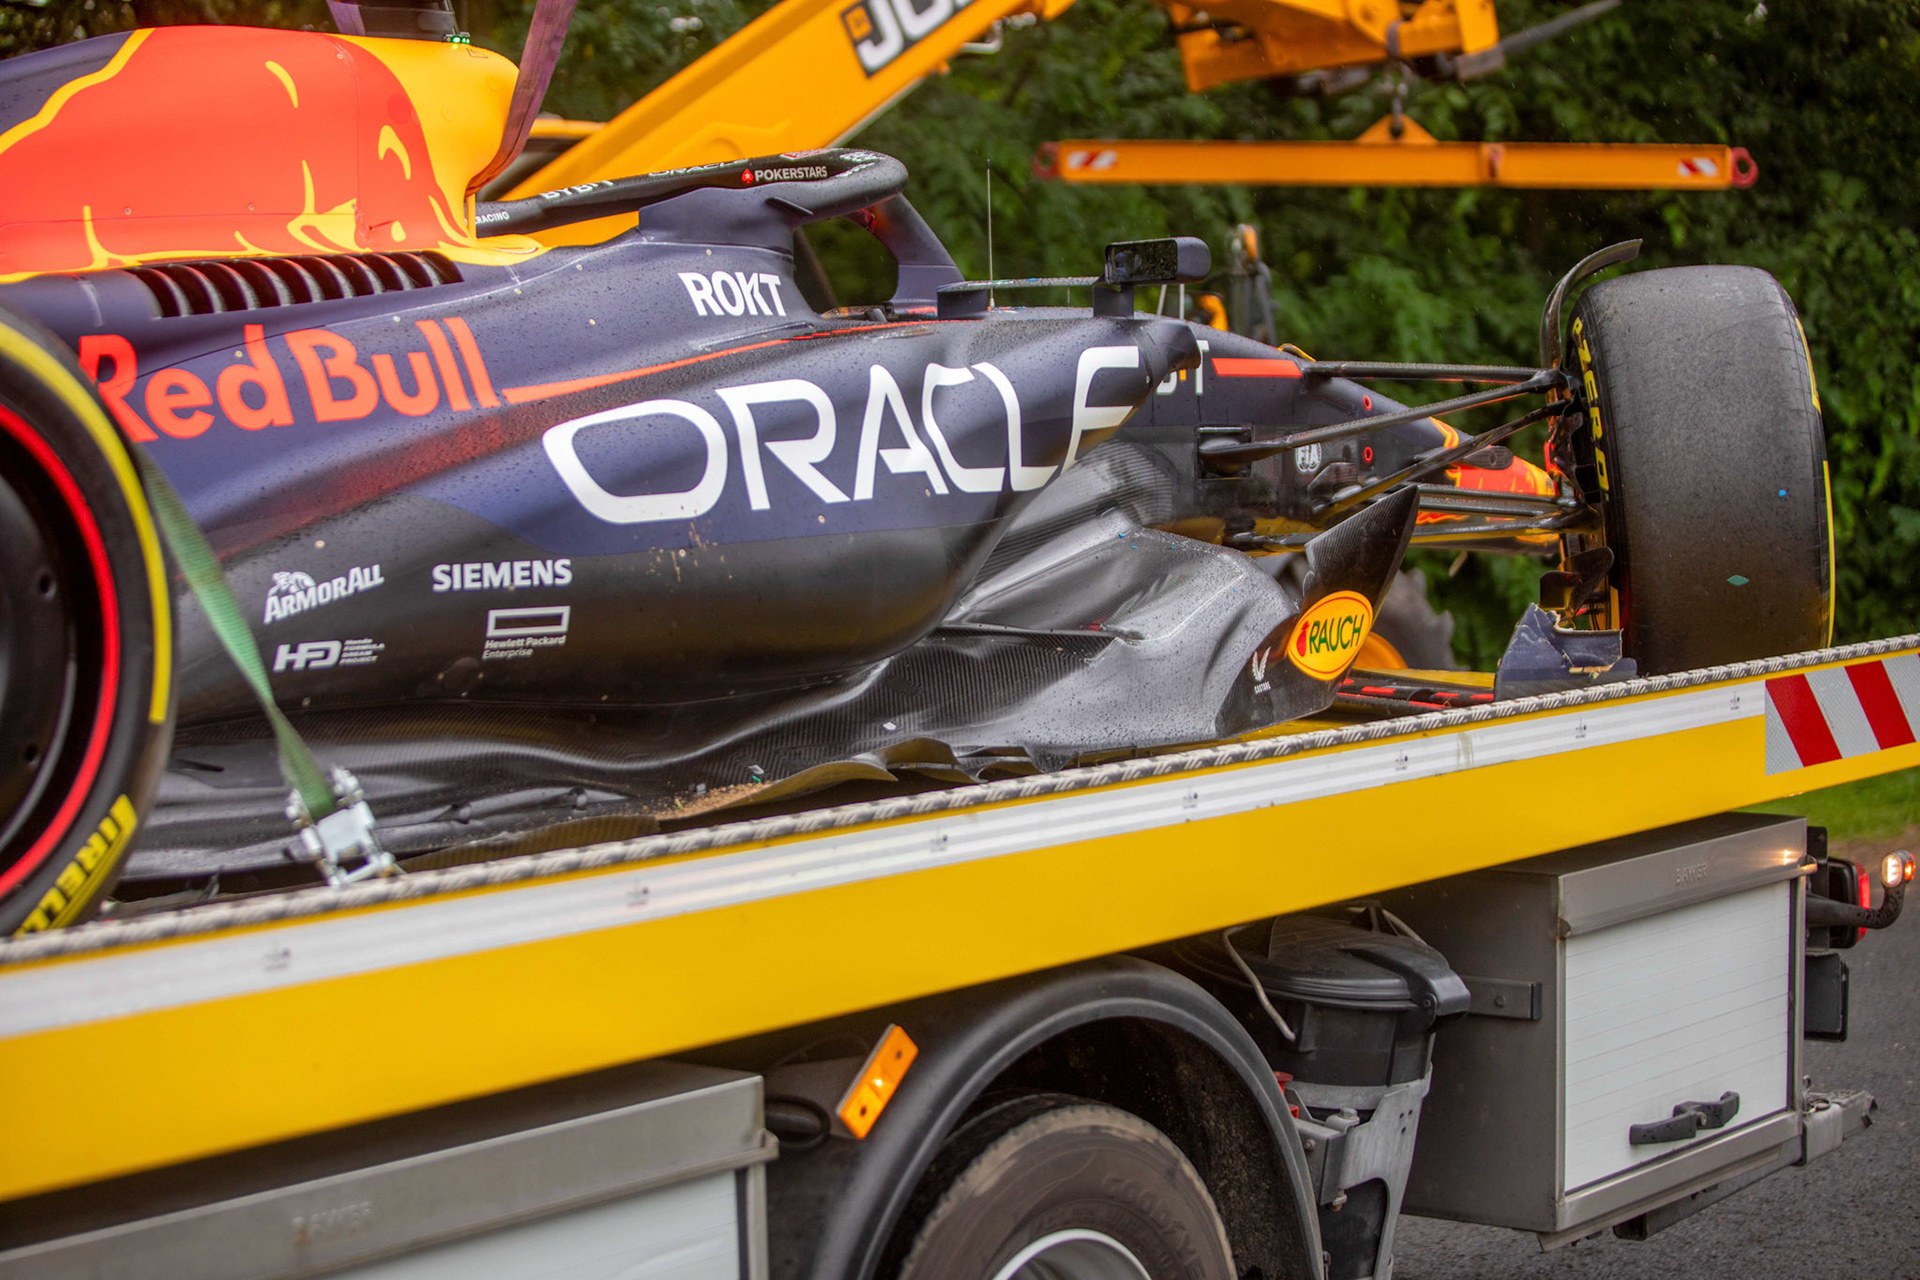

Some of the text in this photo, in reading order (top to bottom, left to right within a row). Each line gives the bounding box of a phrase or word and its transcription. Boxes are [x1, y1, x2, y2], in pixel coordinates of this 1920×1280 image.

[857, 0, 975, 71] JC
[754, 165, 828, 182] POKERSTARS
[476, 211, 510, 225] RACING
[677, 270, 787, 317] ROKT
[79, 316, 501, 443] Red Bull
[542, 345, 1140, 525] ORACLE
[431, 558, 573, 593] SIEMENS
[481, 648, 534, 661] Enterprise
[484, 635, 567, 650] Hewlett Packard
[1309, 613, 1365, 655] RAUCH
[12, 794, 138, 939] PIRELL
